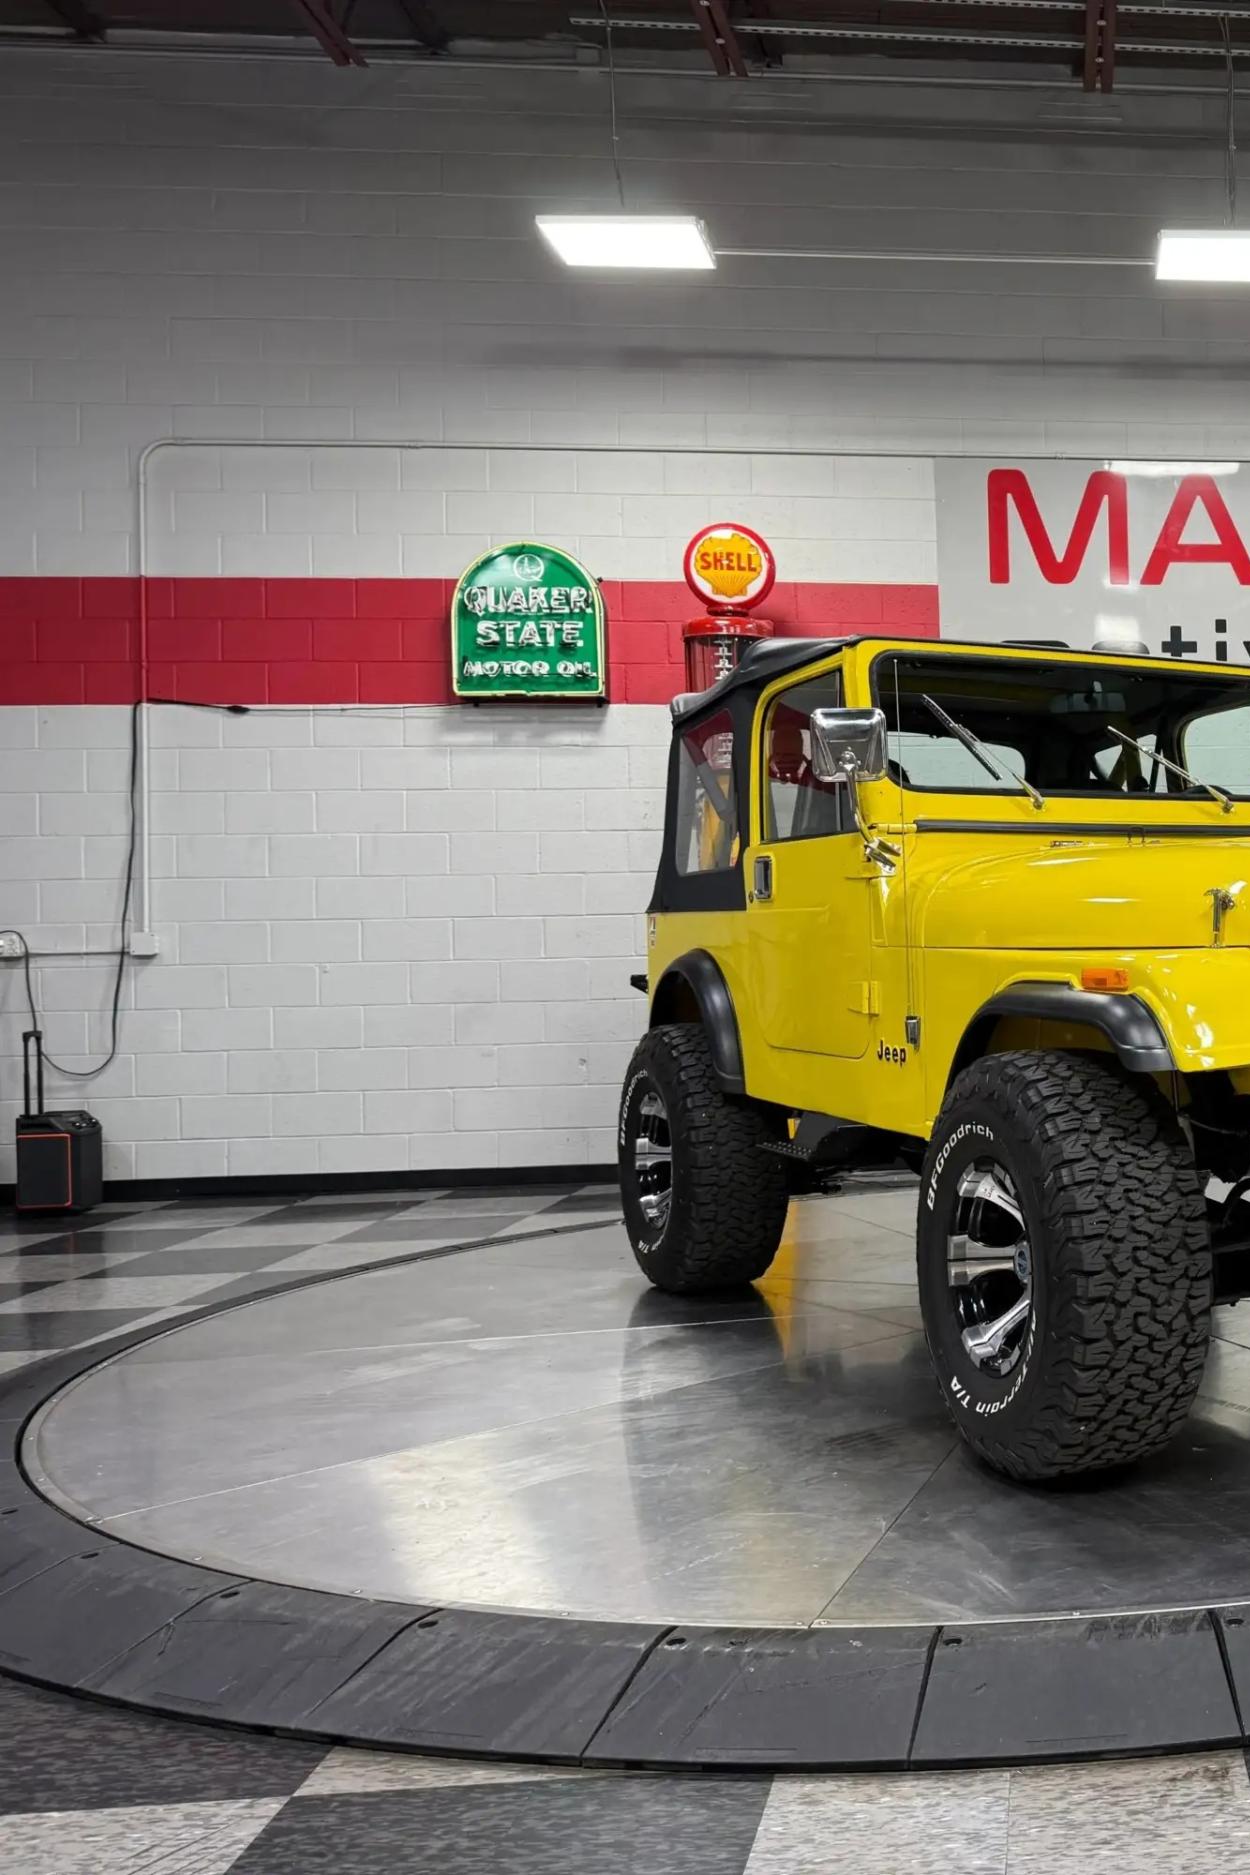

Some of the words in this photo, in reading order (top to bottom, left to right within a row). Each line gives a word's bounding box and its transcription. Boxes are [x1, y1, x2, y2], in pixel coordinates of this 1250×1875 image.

[700, 551, 757, 572] SHELL
[464, 586, 593, 616] QUAKER
[476, 620, 584, 647] STATE
[464, 660, 550, 677] MOTOR
[557, 660, 597, 677] OIL
[877, 1039, 906, 1069] Jeep
[927, 1121, 994, 1211] BFGoodrich
[950, 1376, 971, 1408] T/A
